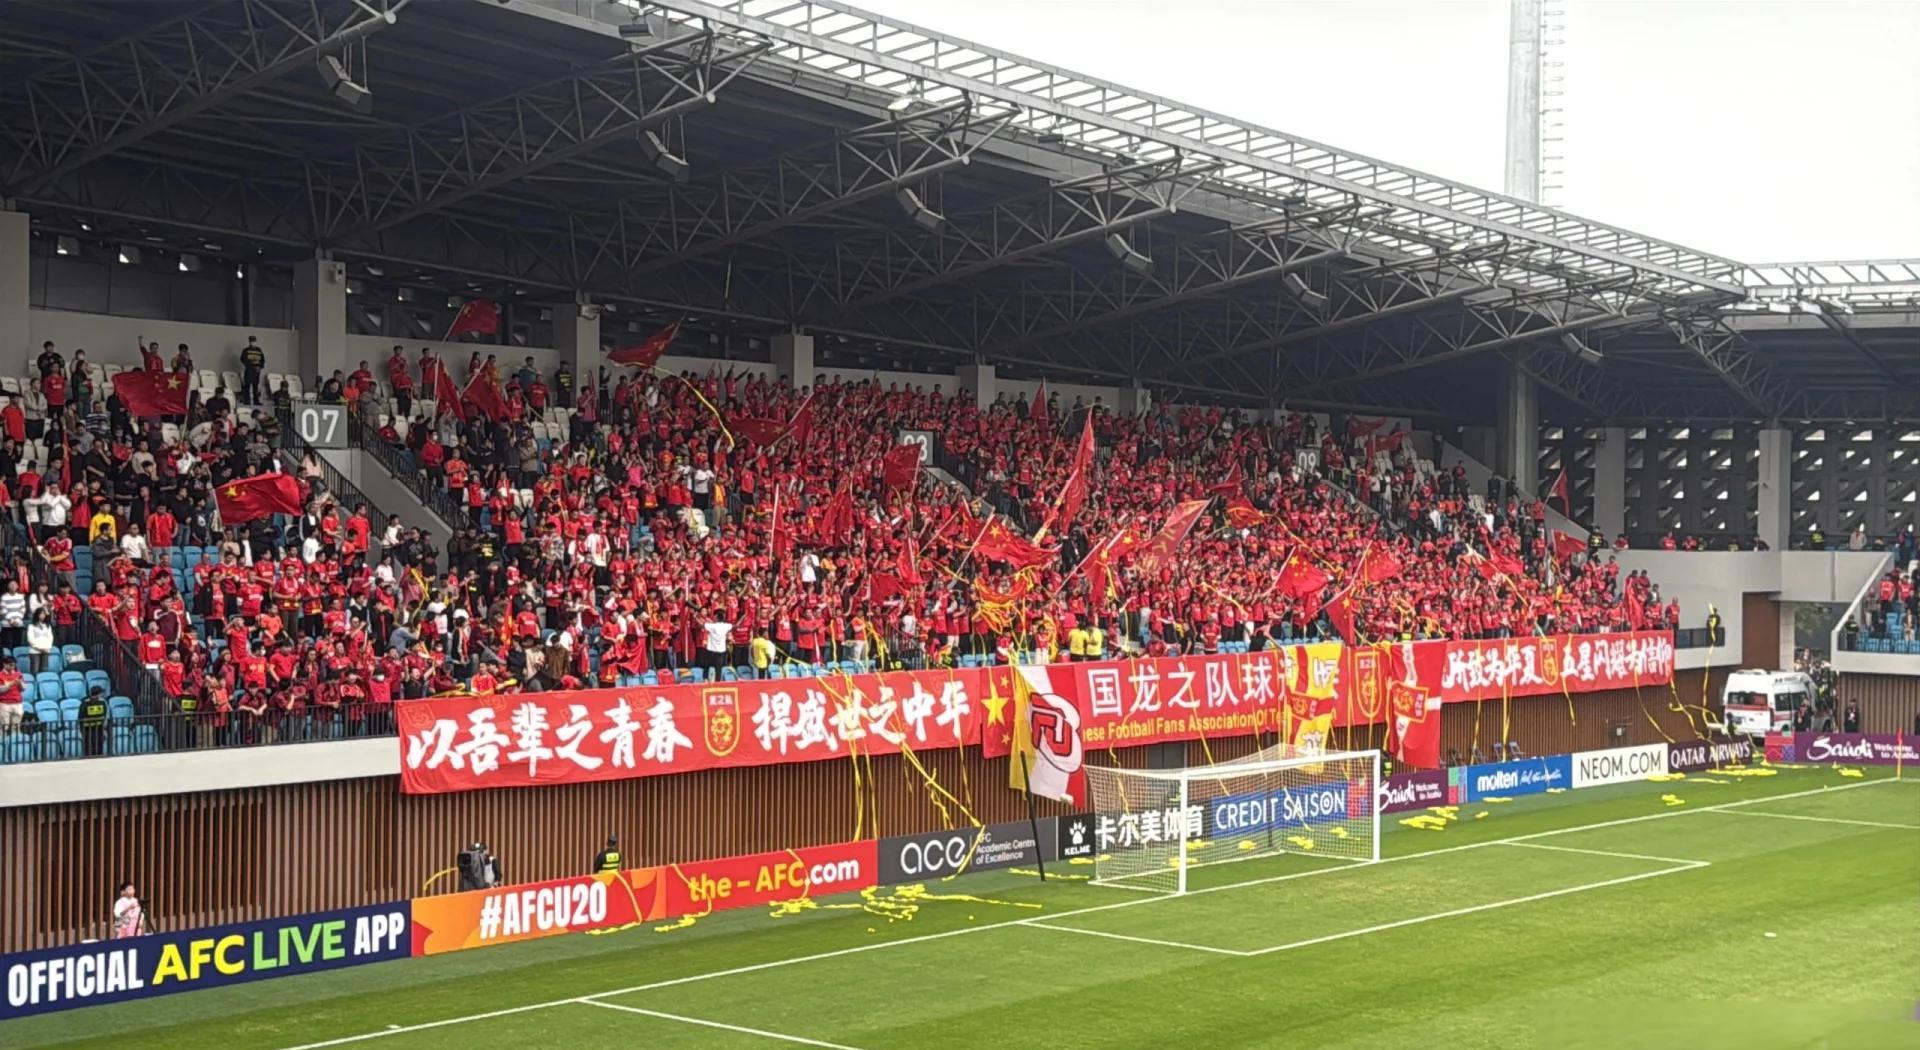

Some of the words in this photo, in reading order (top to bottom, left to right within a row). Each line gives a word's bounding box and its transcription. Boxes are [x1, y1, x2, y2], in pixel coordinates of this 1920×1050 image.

[302, 408, 339, 443] 07
[752, 681, 970, 755] 捍盛世之中华
[1108, 719, 1154, 740] Football
[1157, 717, 1185, 735] Fans
[1188, 712, 1254, 731] Association
[406, 697, 693, 777] 以吾辈之青春
[1807, 735, 1874, 760] Saudi
[1580, 750, 1661, 781] NEOM.COM
[1670, 746, 1706, 769] QATAR
[1709, 740, 1750, 763] AIRWAYS
[1477, 770, 1518, 792] molten
[1216, 798, 1278, 829] CREDIT
[1283, 789, 1345, 820] SAISON
[1095, 805, 1204, 850] 卡尔美体育
[901, 836, 966, 875] ace
[976, 840, 1012, 854] Academic
[1012, 839, 1036, 850] Centr
[976, 854, 984, 865] of
[985, 851, 1024, 864] Excellence
[1064, 845, 1091, 856] KELME
[479, 880, 607, 940] #AFCU20
[8, 948, 144, 1007] OFFICIAL
[152, 935, 245, 985] AFC
[253, 920, 345, 970] LIVE
[354, 912, 405, 955] APP
